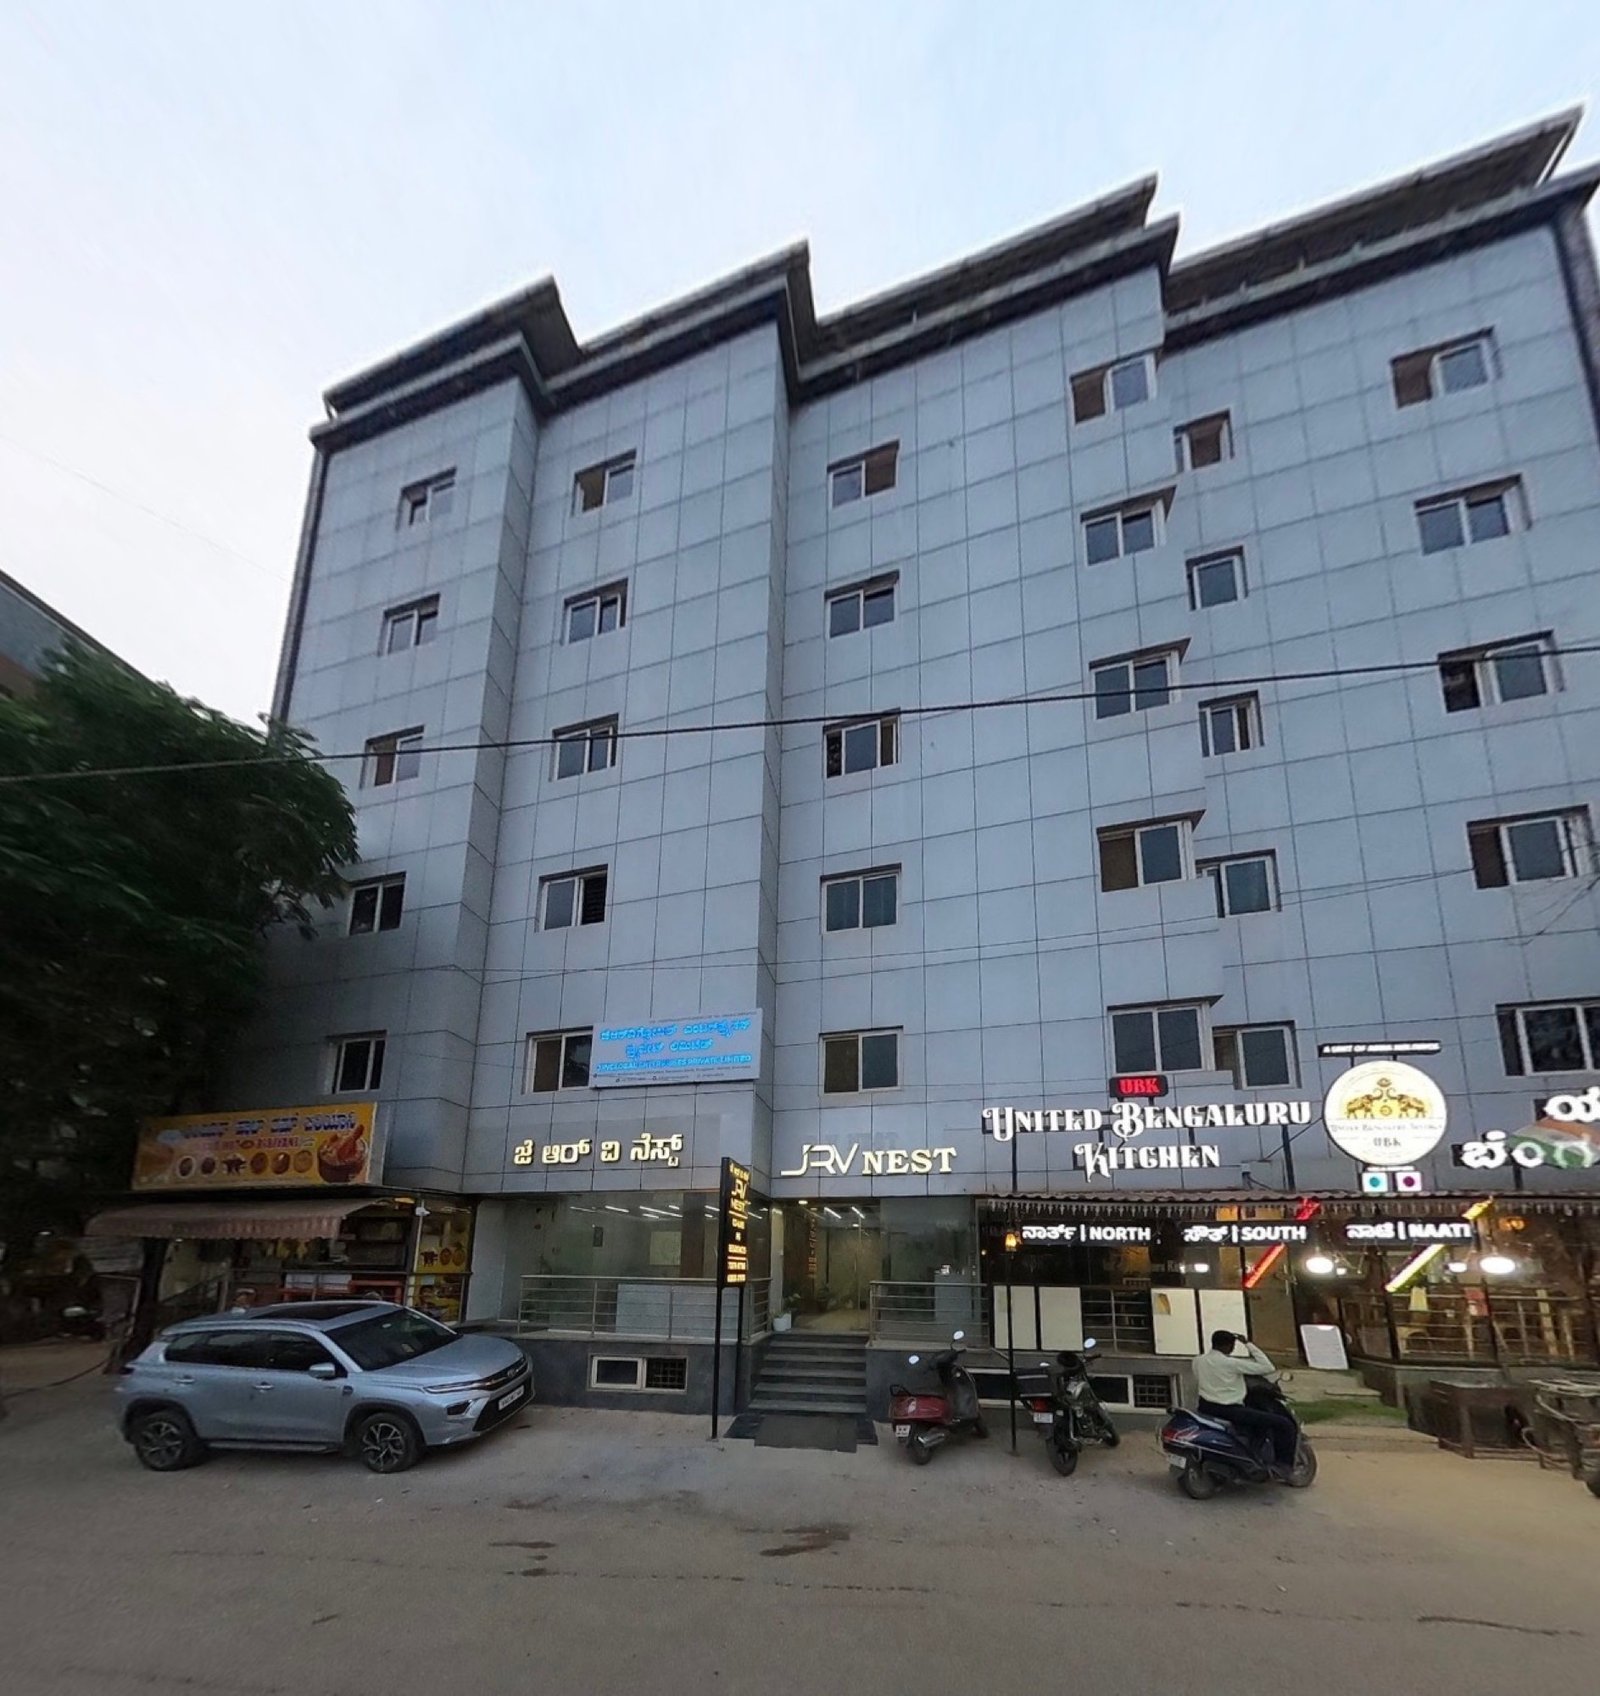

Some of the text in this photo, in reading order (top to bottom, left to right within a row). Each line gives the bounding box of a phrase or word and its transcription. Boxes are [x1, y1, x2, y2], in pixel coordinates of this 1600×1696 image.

[1119, 1077, 1160, 1095] UBK
[982, 1100, 1312, 1142] UNITED BENGALURU
[513, 1133, 683, 1167] ಜೆ ಆರ್ ವಿ ನೆಸ್ಟ್
[781, 1143, 859, 1176] JRV
[861, 1147, 957, 1175] NEST
[1074, 1142, 1220, 1183] KITCHEN
[1089, 1226, 1151, 1241] NORTH
[1241, 1225, 1307, 1241] SOUTH
[1408, 1222, 1471, 1238] NAATI
